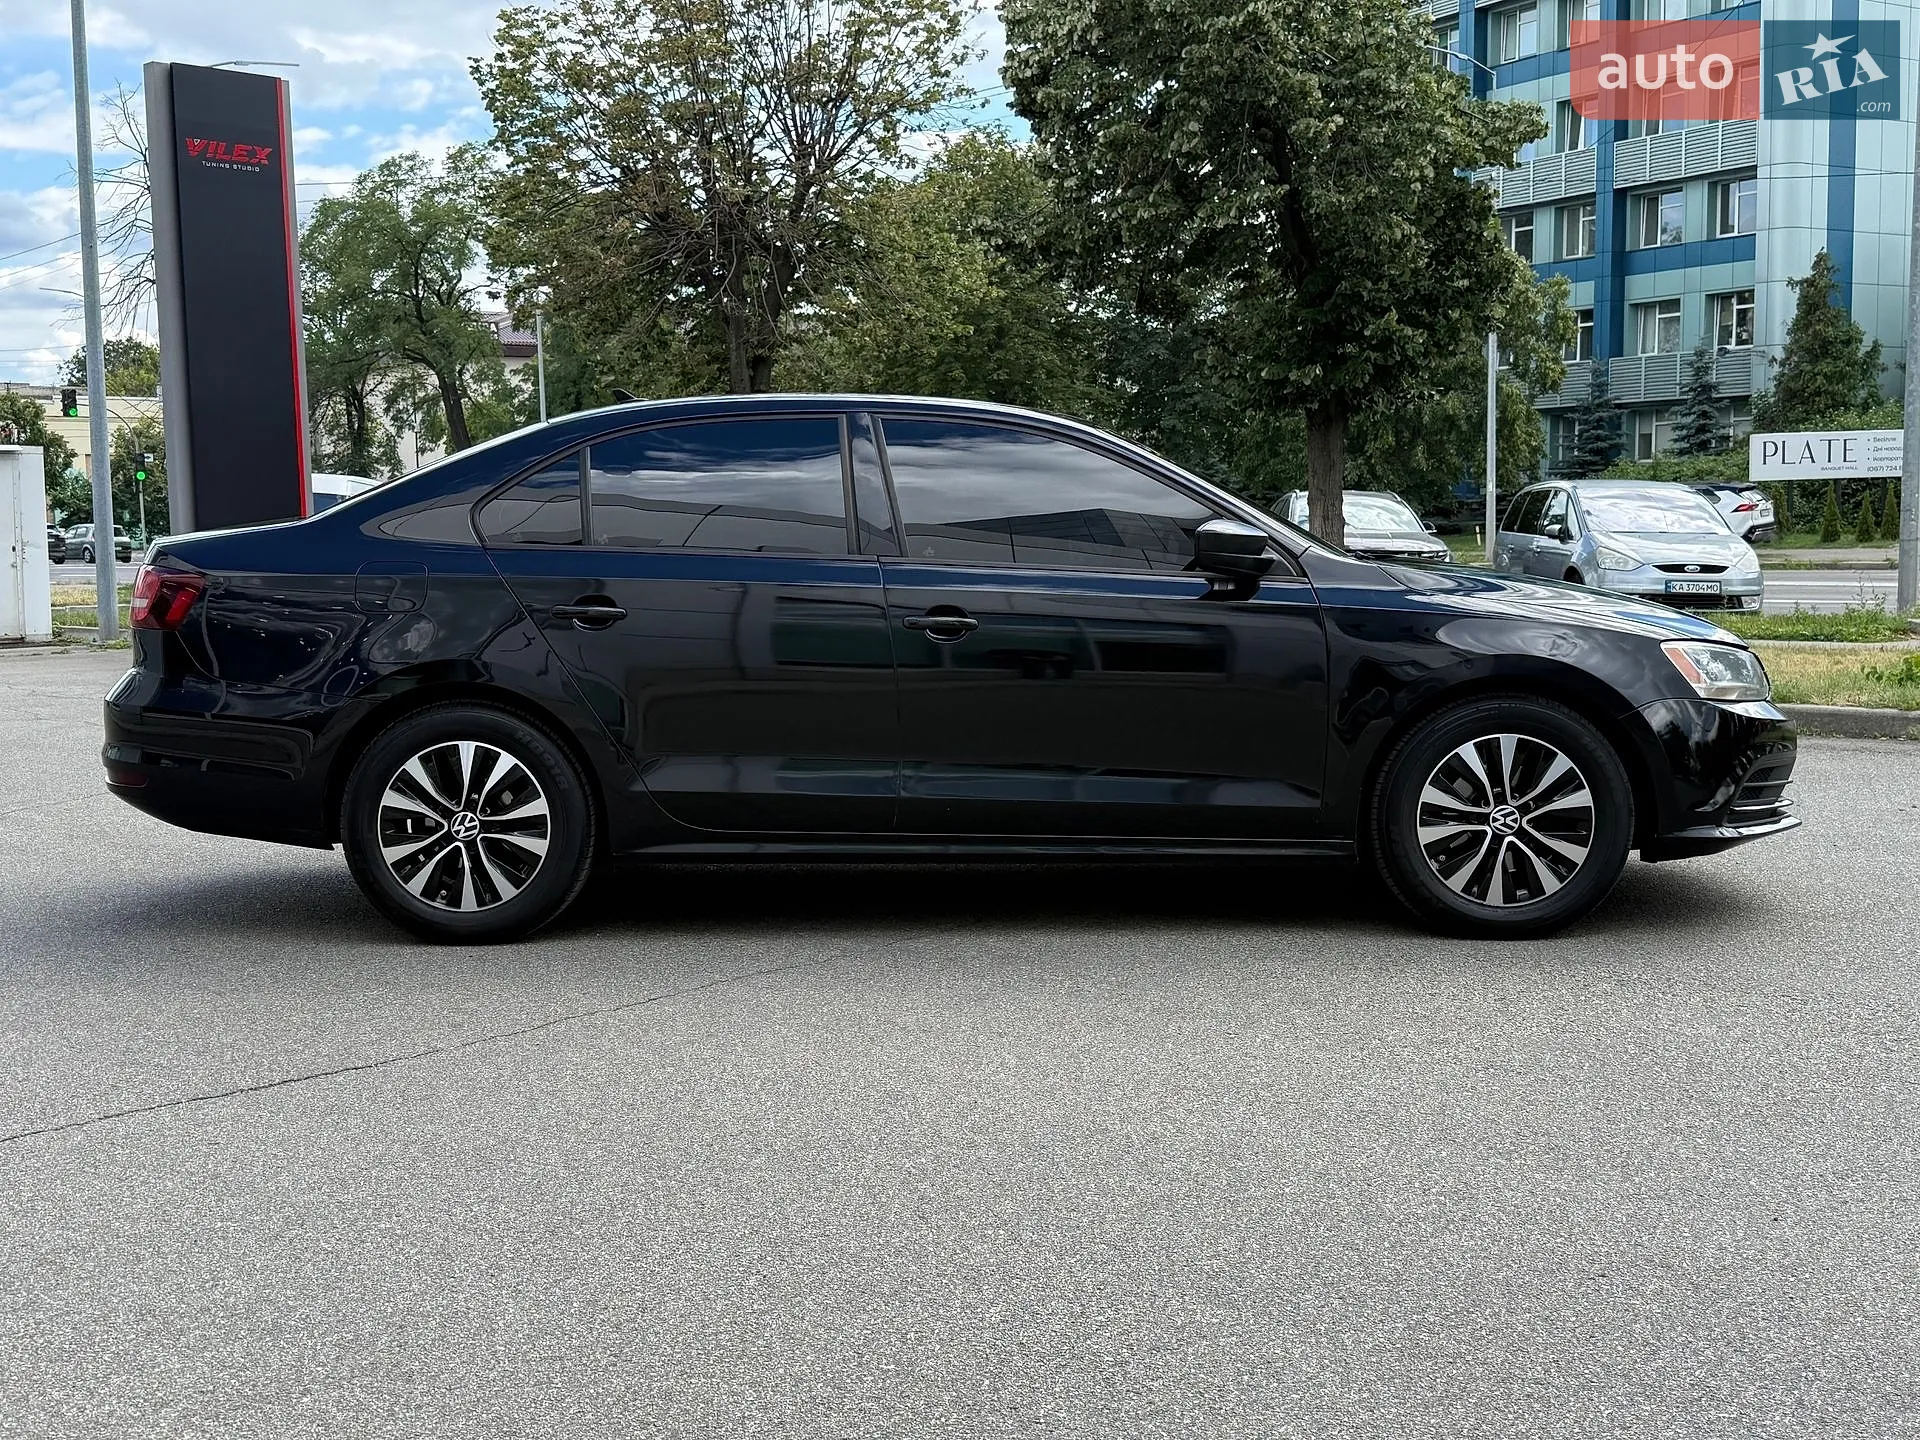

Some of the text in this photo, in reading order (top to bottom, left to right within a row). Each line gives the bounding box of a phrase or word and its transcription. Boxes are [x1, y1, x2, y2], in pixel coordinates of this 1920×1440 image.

[185, 137, 272, 164] VILEX
[201, 160, 260, 172] TUNING STUDIO
[1762, 438, 1858, 465] PLATE
